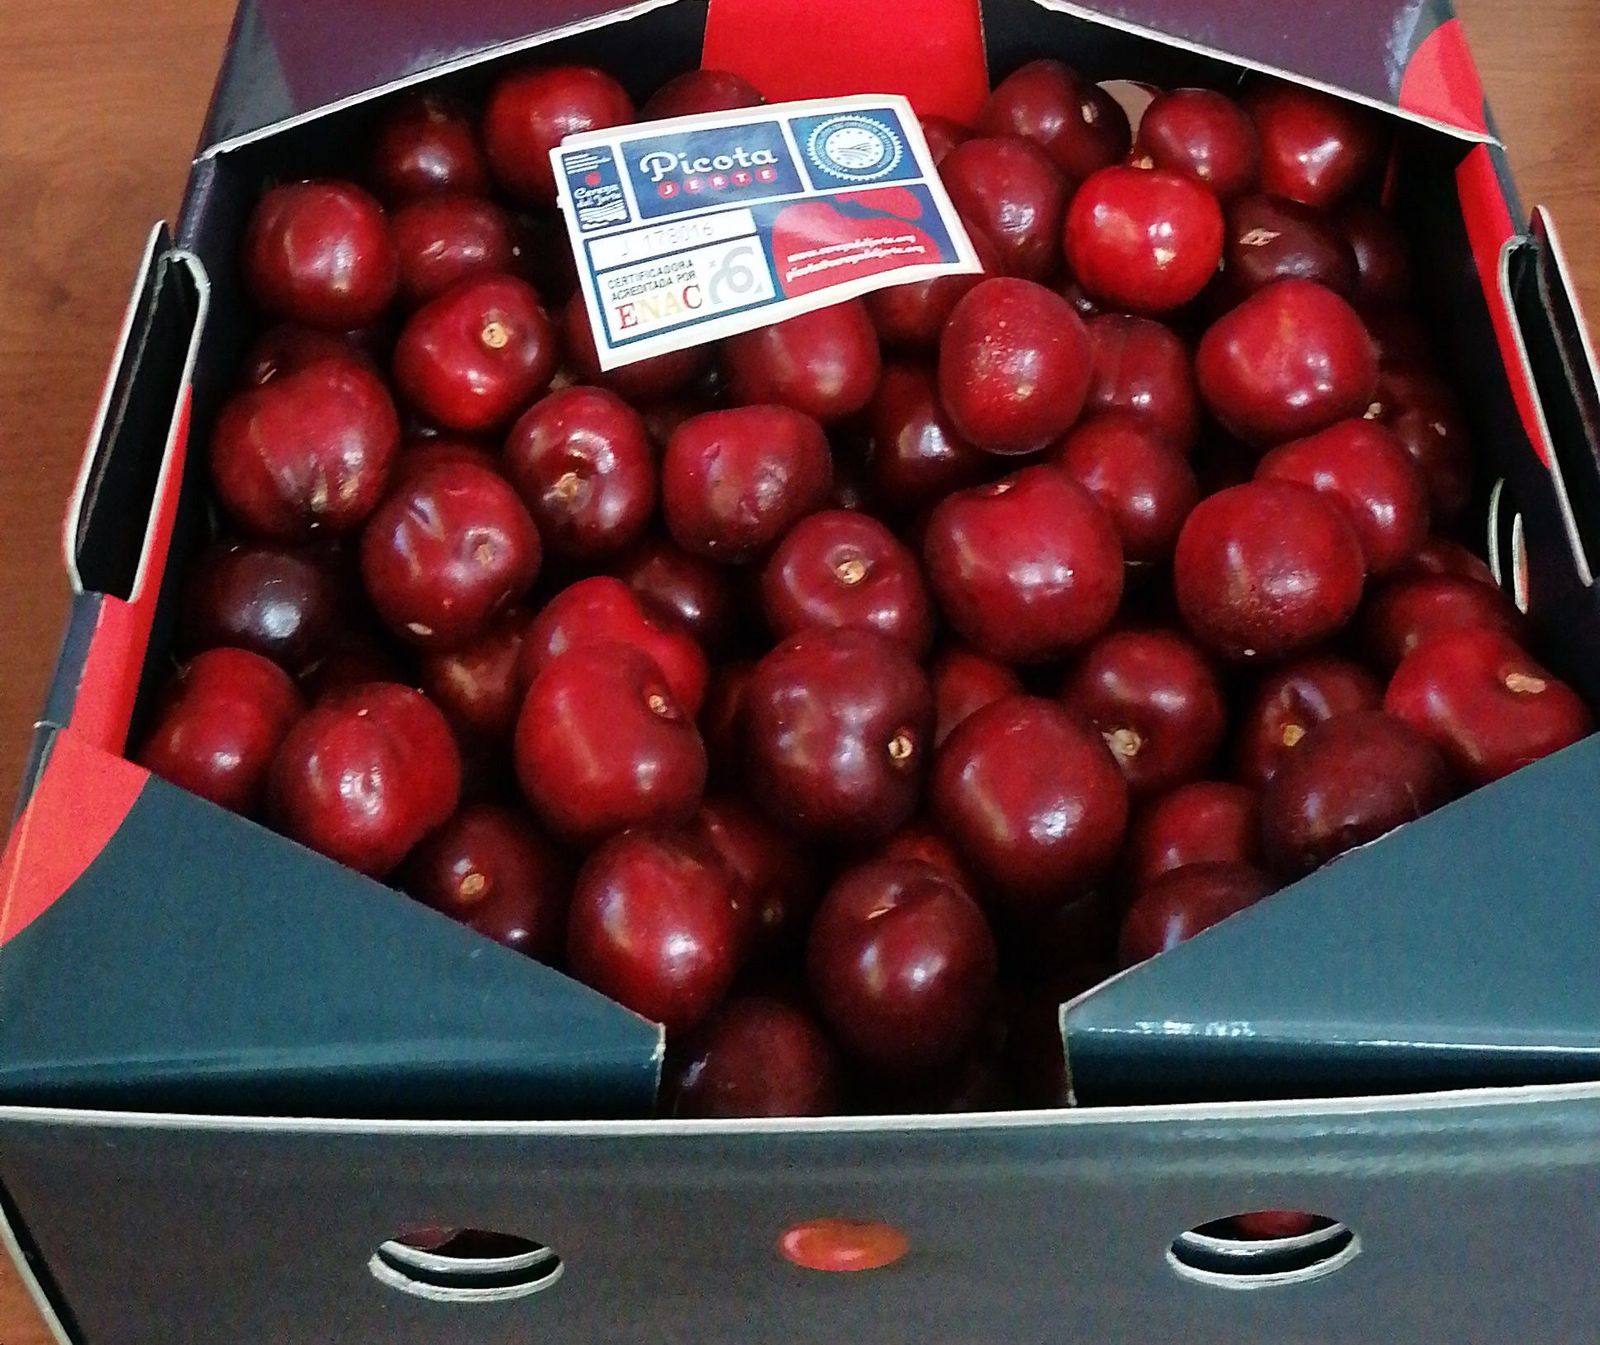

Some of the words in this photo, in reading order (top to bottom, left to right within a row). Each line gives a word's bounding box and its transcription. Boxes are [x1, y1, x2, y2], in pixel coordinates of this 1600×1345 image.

[640, 147, 778, 182] Picota
[663, 169, 771, 195] JERTE
[607, 259, 693, 290] CERTIFICADORA
[612, 277, 673, 302] ACREDITADA
[676, 270, 696, 283] POR
[615, 284, 703, 329] ENAC
